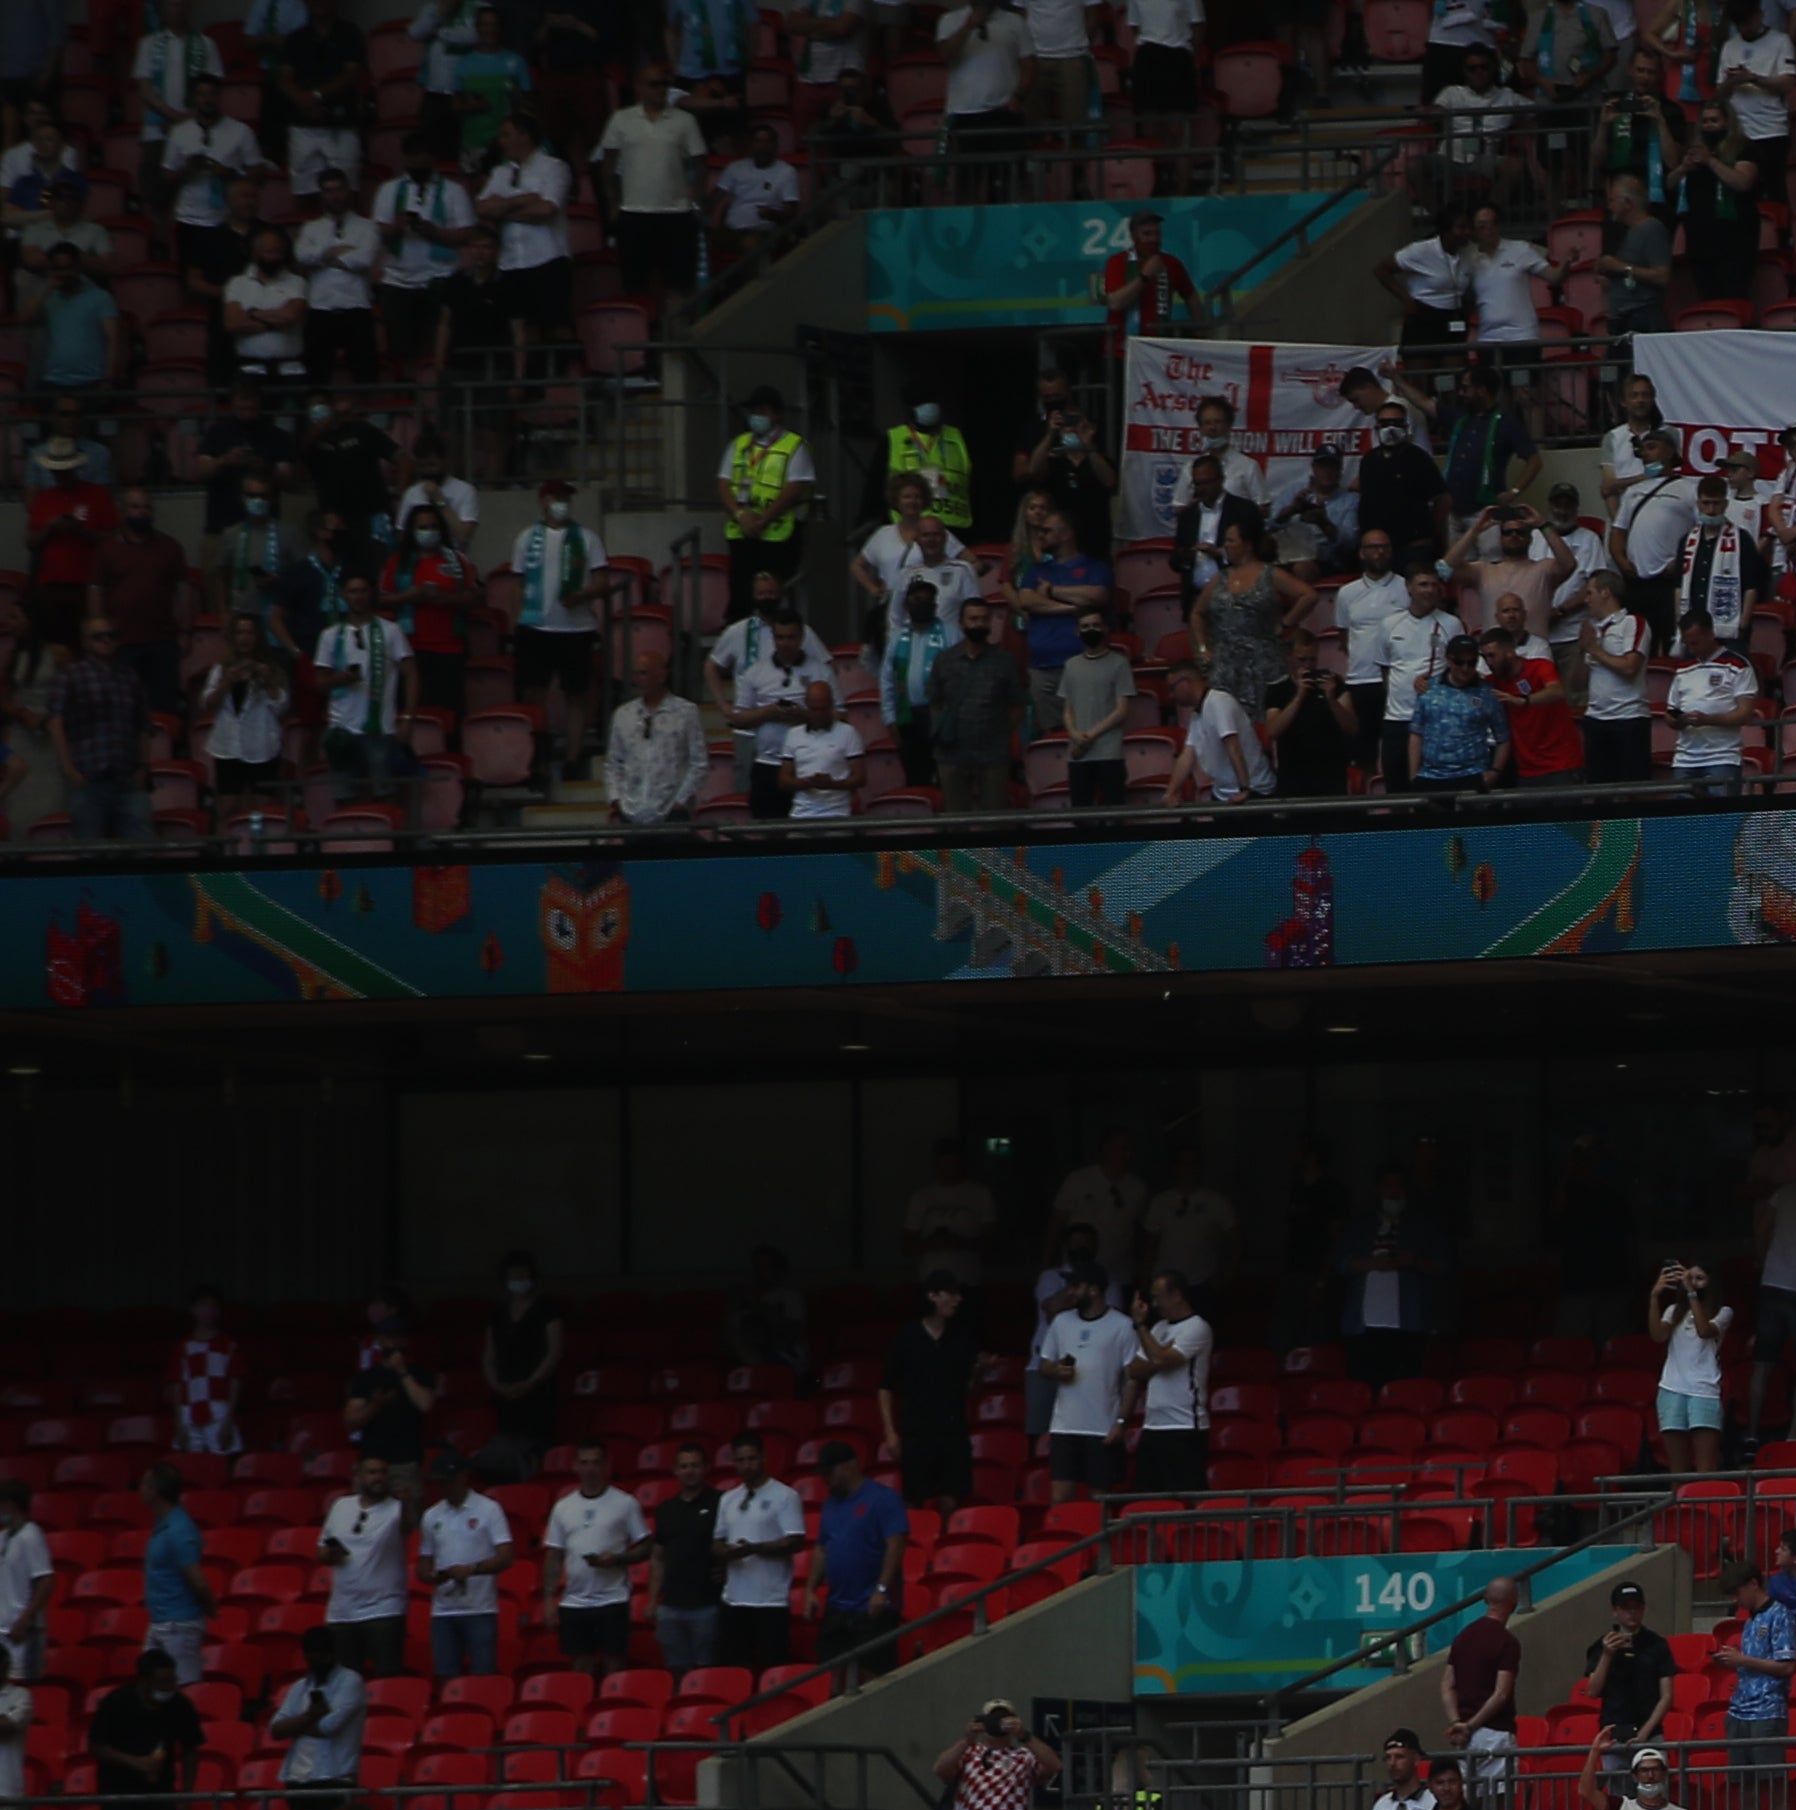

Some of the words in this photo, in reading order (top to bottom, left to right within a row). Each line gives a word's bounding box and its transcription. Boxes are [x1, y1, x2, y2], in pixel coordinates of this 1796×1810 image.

[1166, 354, 1215, 385] The
[1151, 426, 1184, 452] THE
[1271, 429, 1315, 454] WILL
[1318, 425, 1366, 450] FIRE
[1355, 1571, 1436, 1612] 140
